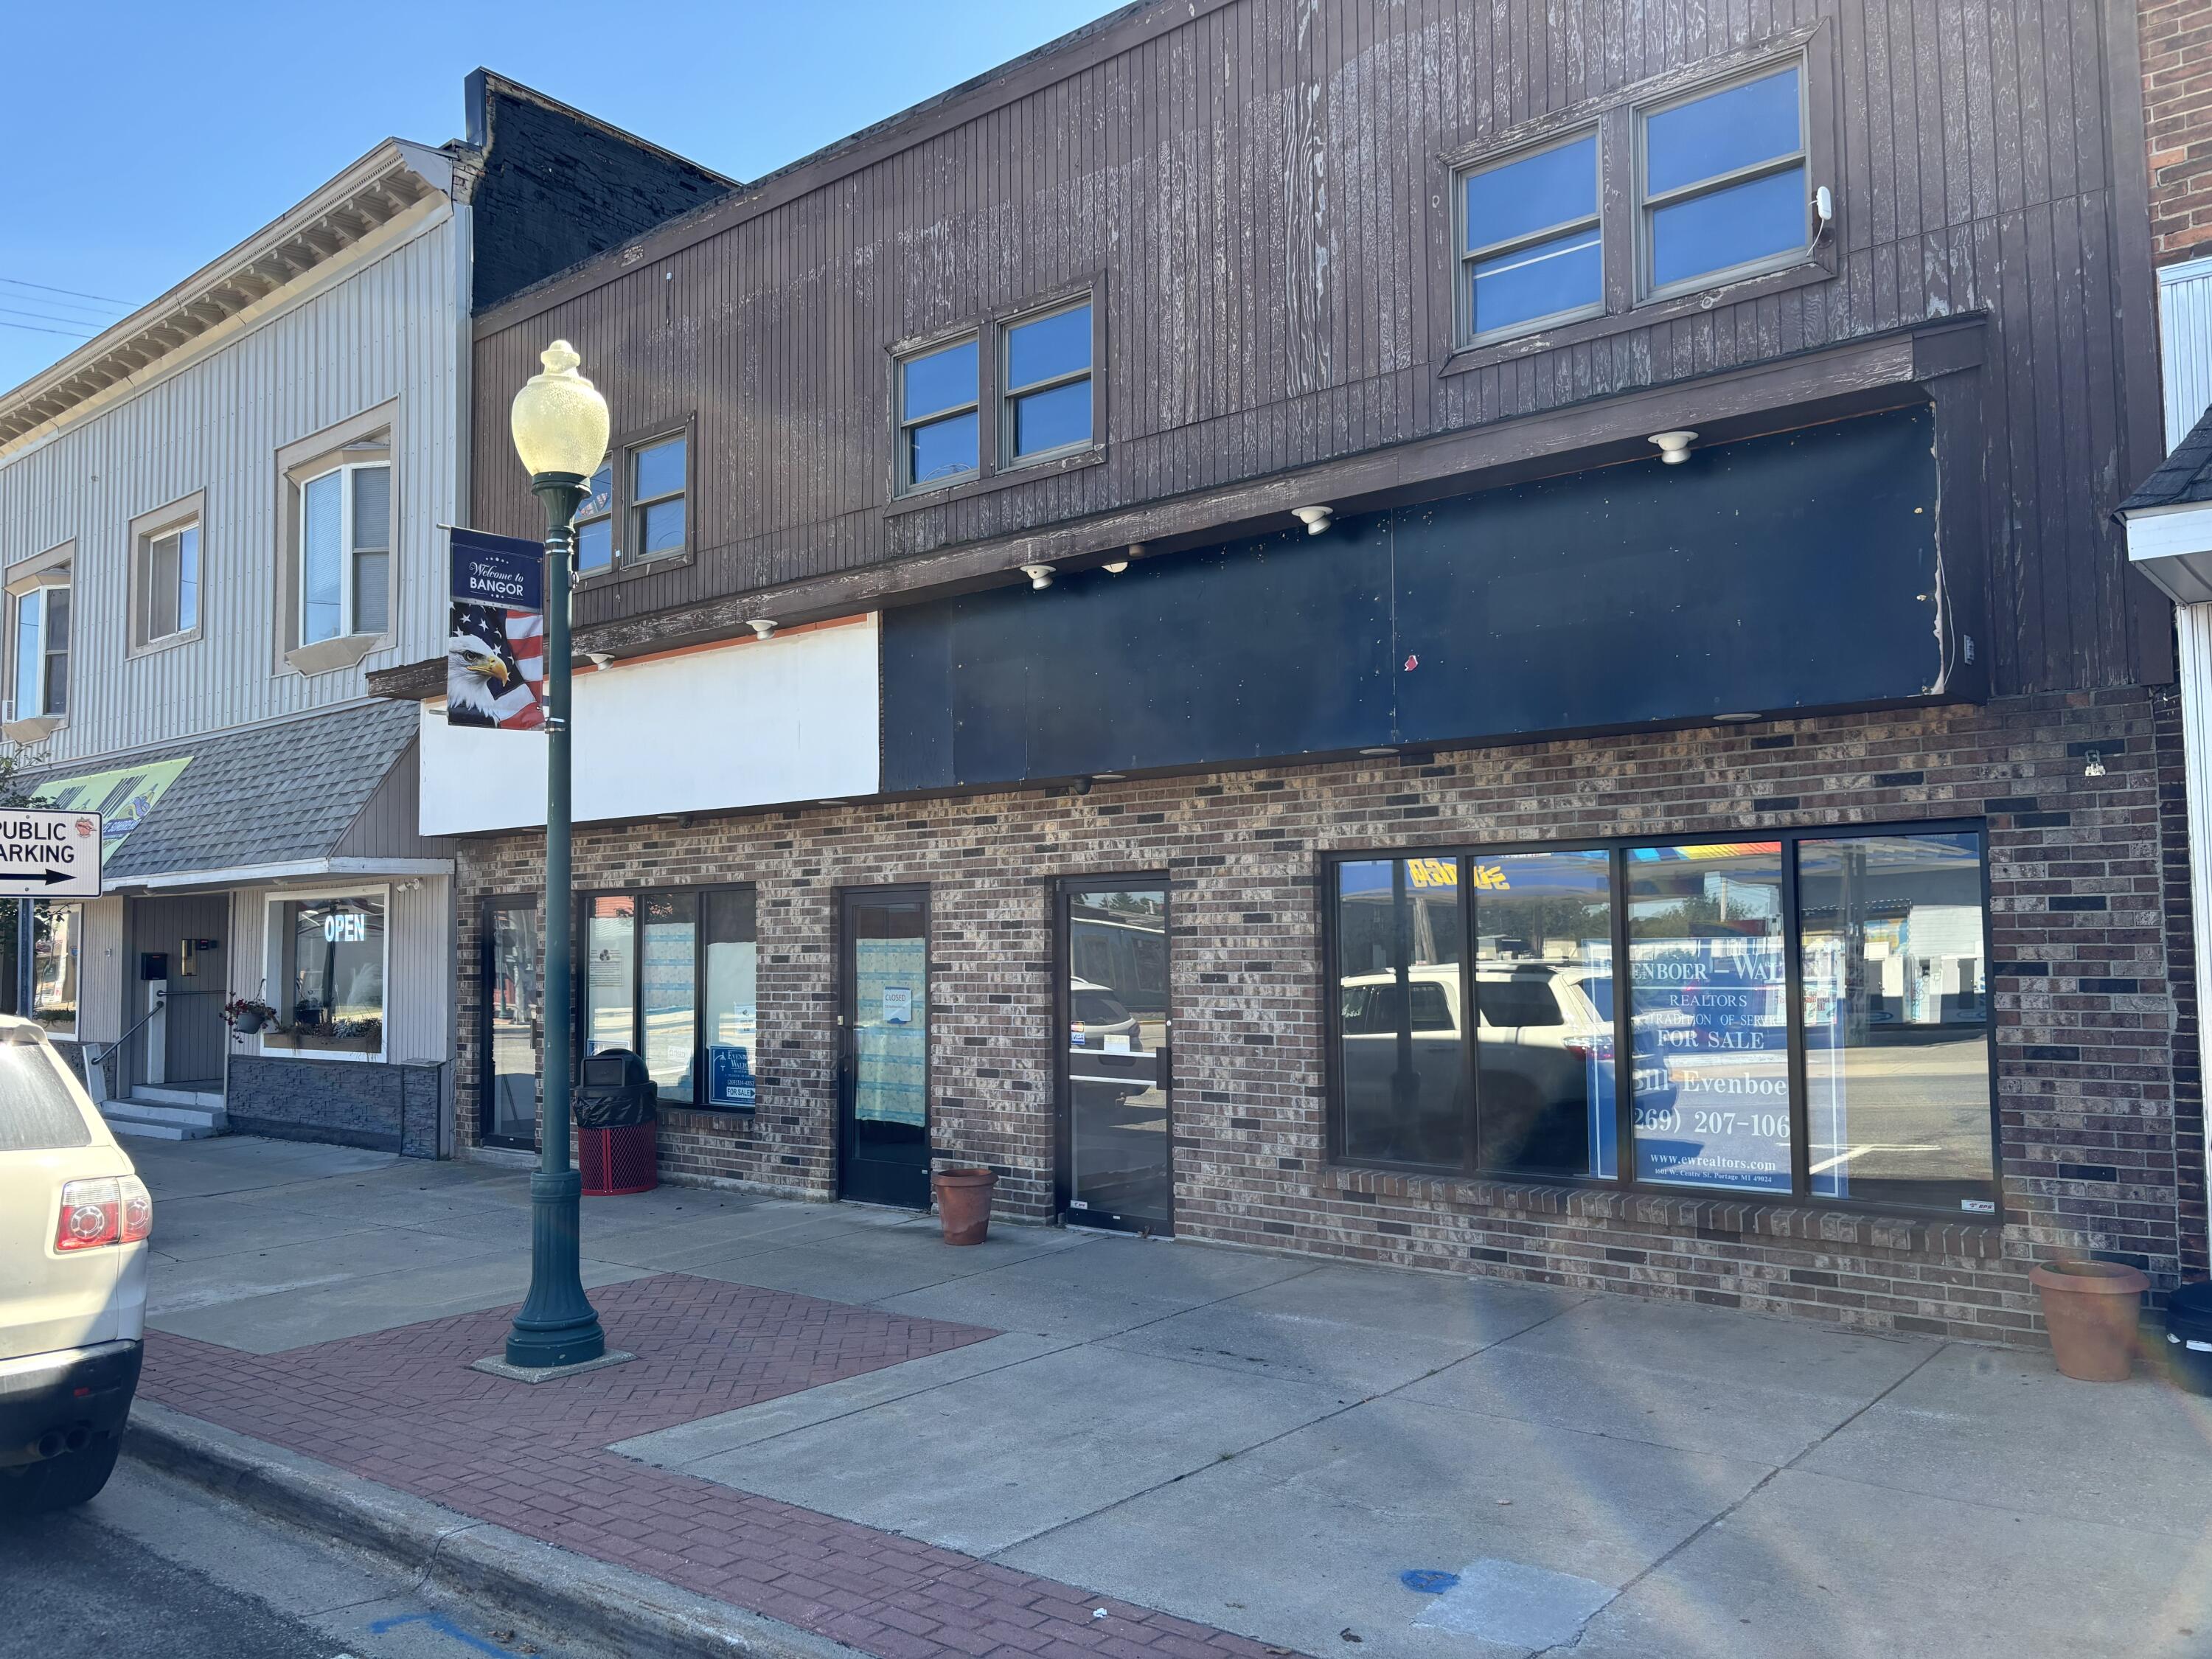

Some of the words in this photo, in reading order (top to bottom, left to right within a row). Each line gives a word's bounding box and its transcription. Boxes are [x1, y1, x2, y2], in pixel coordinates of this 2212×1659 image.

[469, 562, 512, 581] Welcome
[515, 573, 524, 583] to
[470, 577, 524, 597] BANGOR
[0, 821, 67, 841] UBLIC
[324, 914, 365, 942] OPEN
[1669, 995, 1747, 1007] REALTORS
[1650, 1013, 1711, 1026] TRADITION
[1719, 1014, 1735, 1026] OF
[1657, 1029, 1699, 1047] FOR
[1708, 1031, 1764, 1049] SALE
[728, 1088, 738, 1096] FOR
[738, 1089, 751, 1097] SALE
[1650, 1154, 1776, 1172] www.ewrealtors.com
[1680, 1169, 1701, 1178] Centre
[1714, 1173, 1739, 1181] Portage
